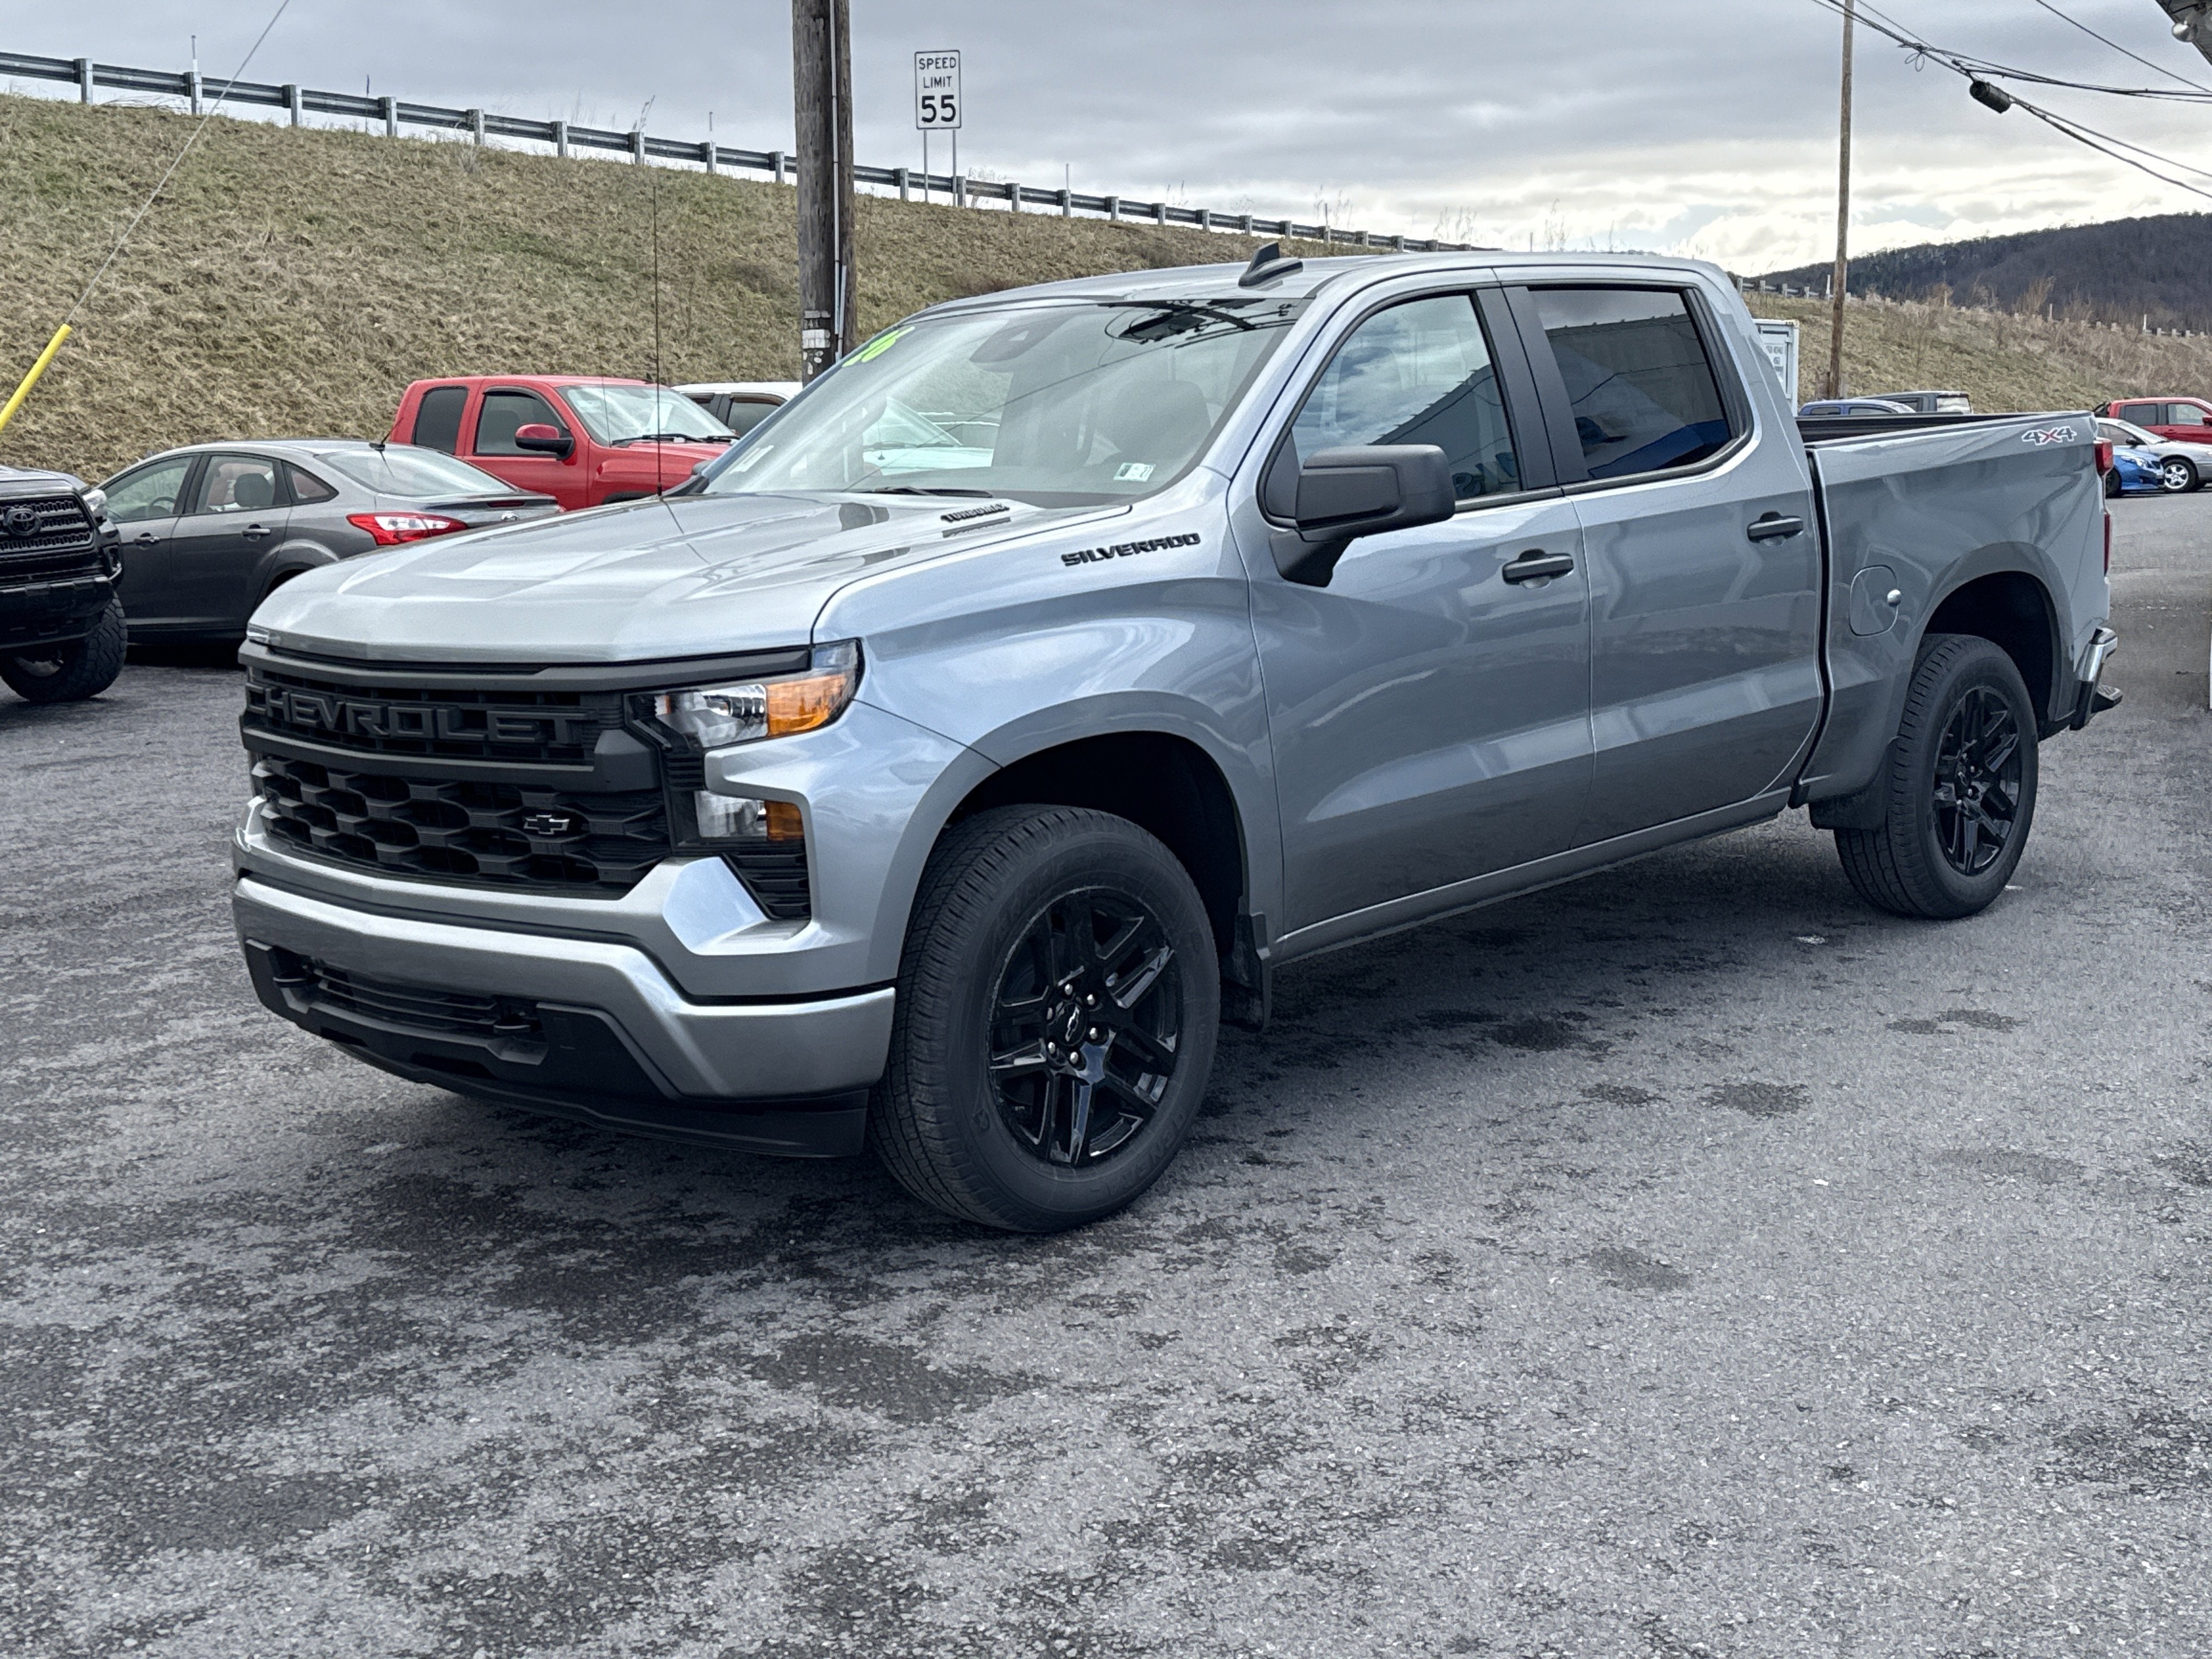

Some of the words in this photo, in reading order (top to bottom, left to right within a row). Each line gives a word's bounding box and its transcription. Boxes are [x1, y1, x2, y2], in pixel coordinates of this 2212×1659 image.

[919, 57, 956, 70] SPEED
[923, 76, 952, 88] LIMIT
[921, 94, 956, 123] 55
[1061, 533, 1201, 566] SILVERADO
[245, 682, 598, 744] CHEVROLET
